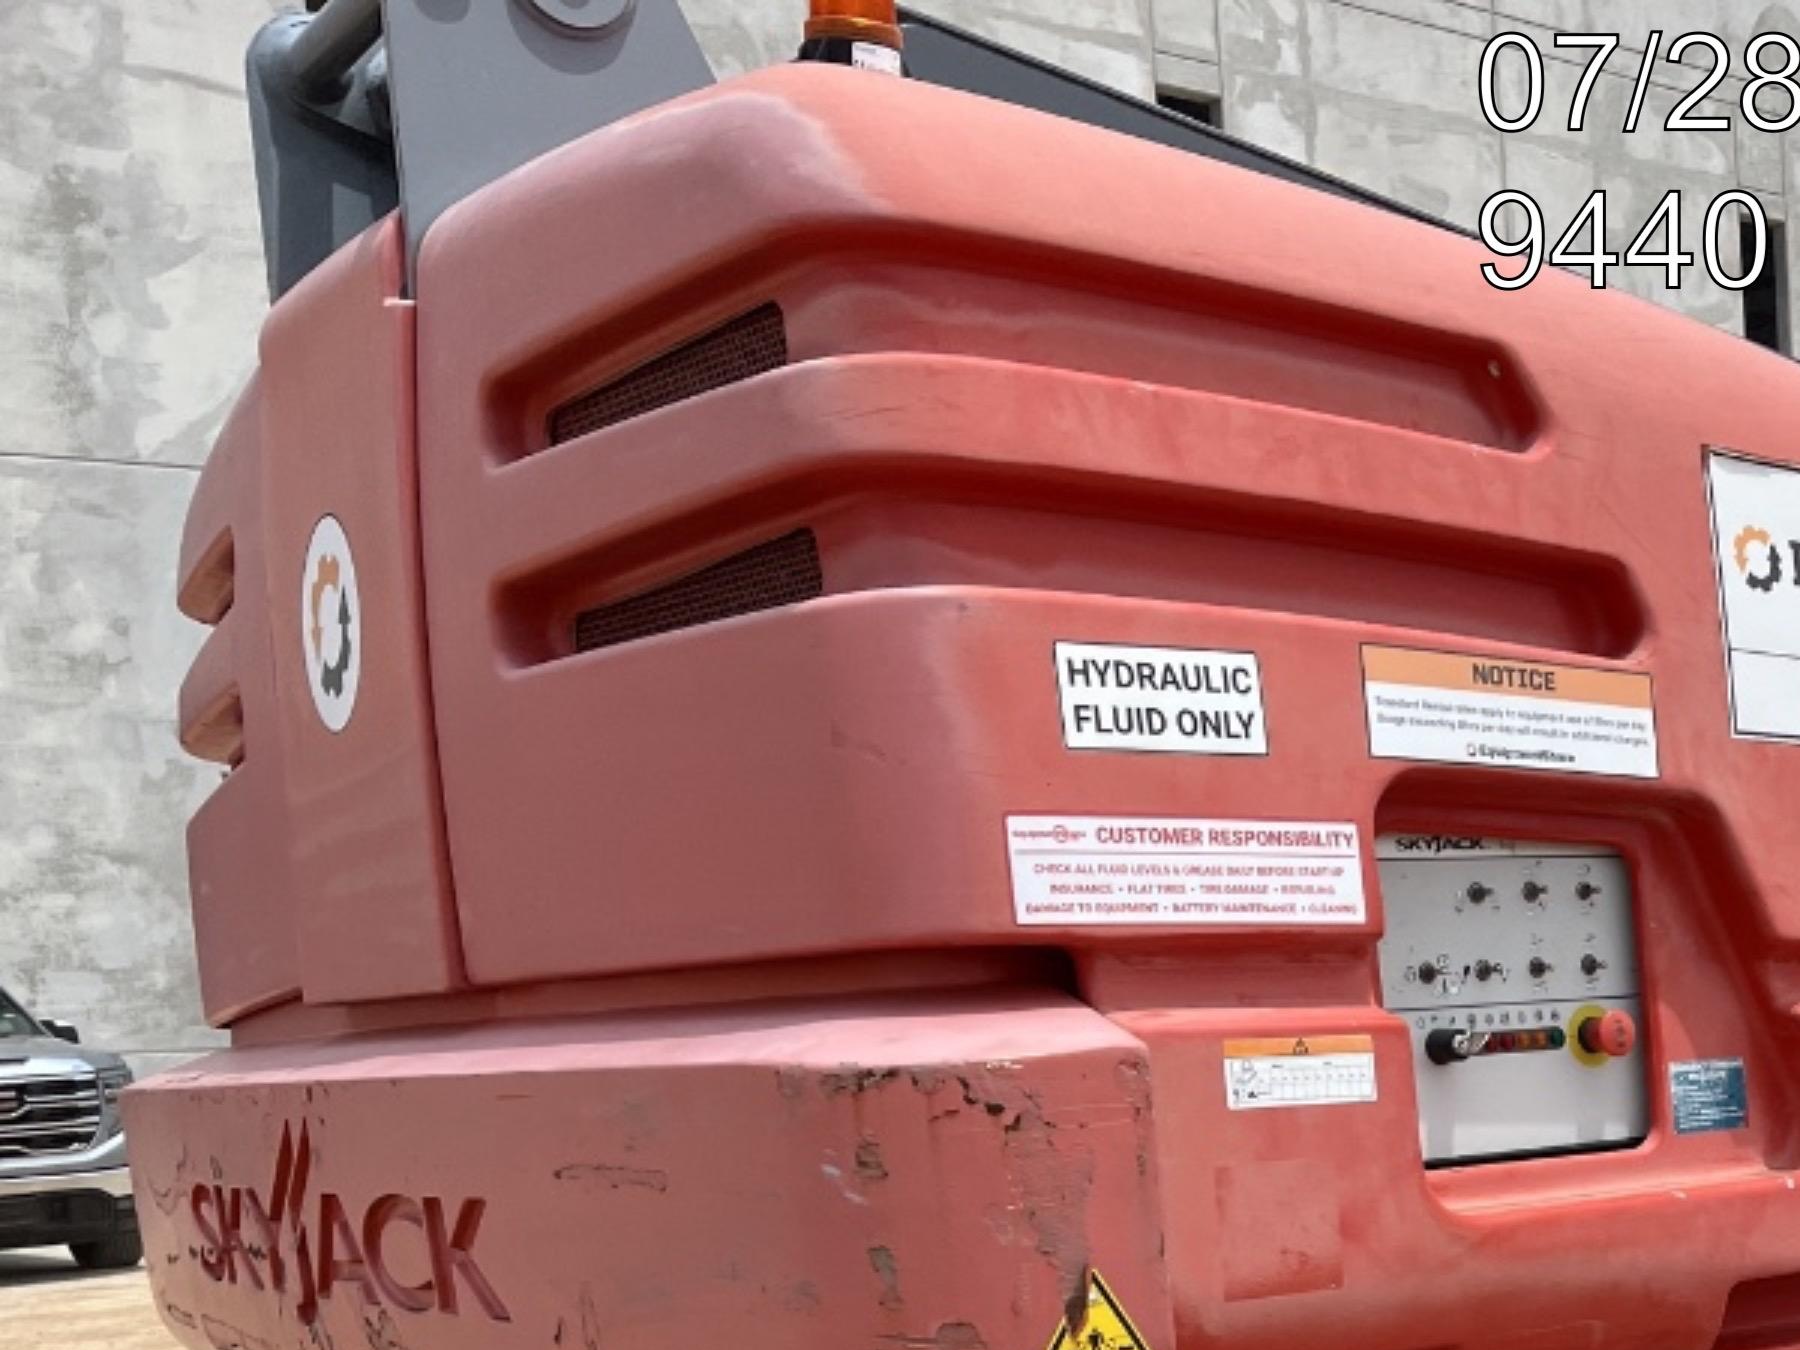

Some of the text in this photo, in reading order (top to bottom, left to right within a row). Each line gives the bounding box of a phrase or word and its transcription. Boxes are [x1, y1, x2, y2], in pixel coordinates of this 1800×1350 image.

[1067, 657, 1252, 695] HYDRAULIC
[1472, 663, 1556, 691] NOTICE
[1073, 704, 1255, 739] FLUID ONLY
[1095, 826, 1203, 847] CUSTOMER
[1208, 830, 1354, 850] RESPONSIBILITY
[190, 1117, 511, 1327] SKYJACK
